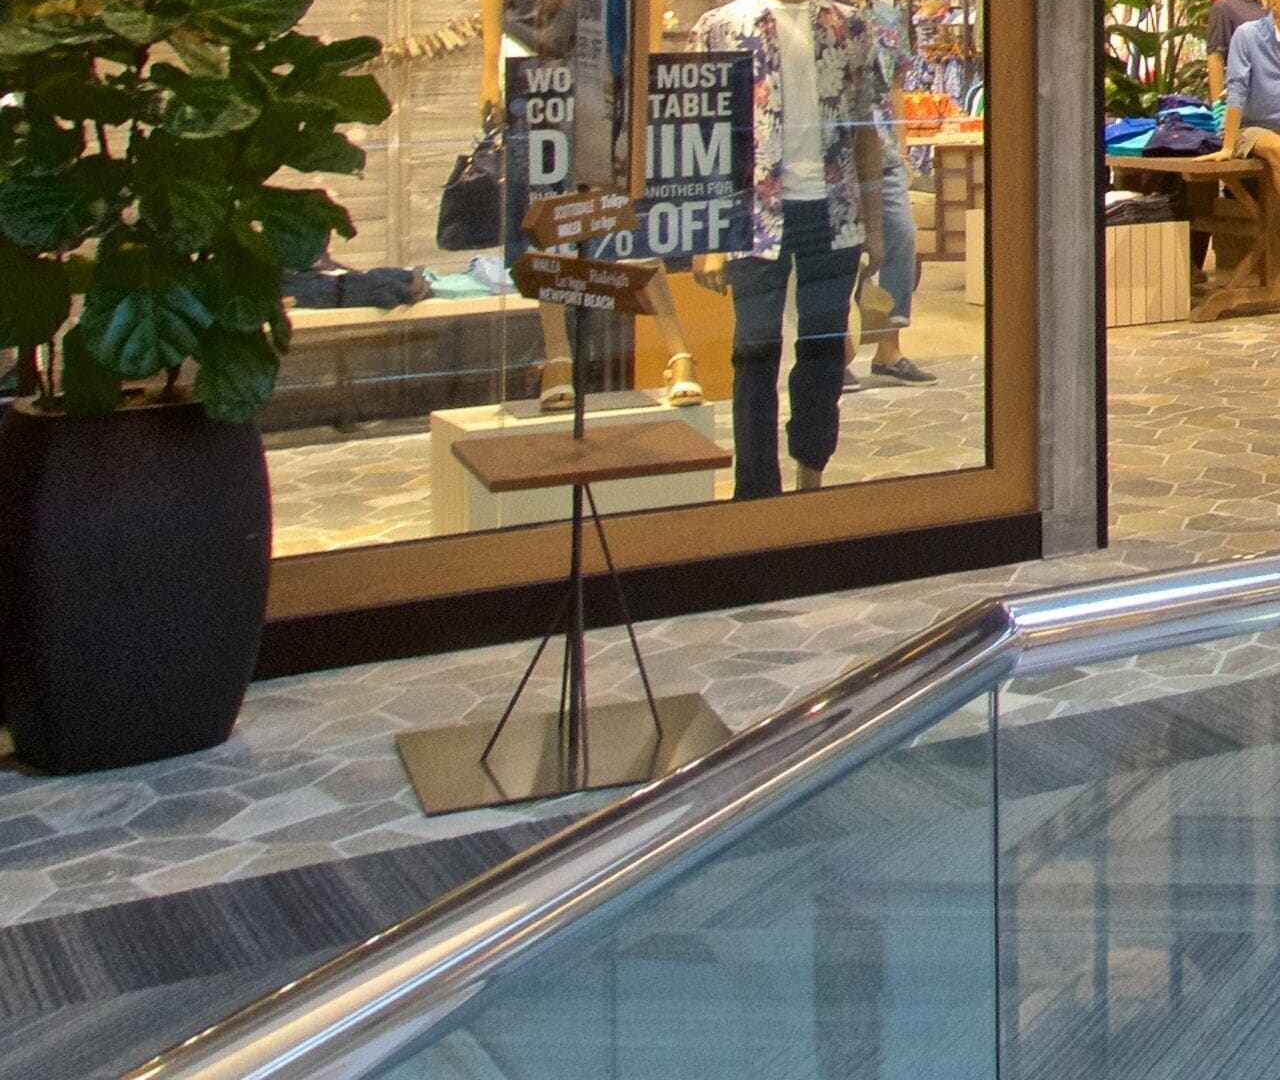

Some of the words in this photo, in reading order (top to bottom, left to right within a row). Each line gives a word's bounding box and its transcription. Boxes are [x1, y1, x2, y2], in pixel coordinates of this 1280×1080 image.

[656, 62, 733, 89] MOST
[707, 180, 733, 195] FOR
[539, 286, 583, 306] NEWPORT
[583, 293, 615, 311] BEACH
